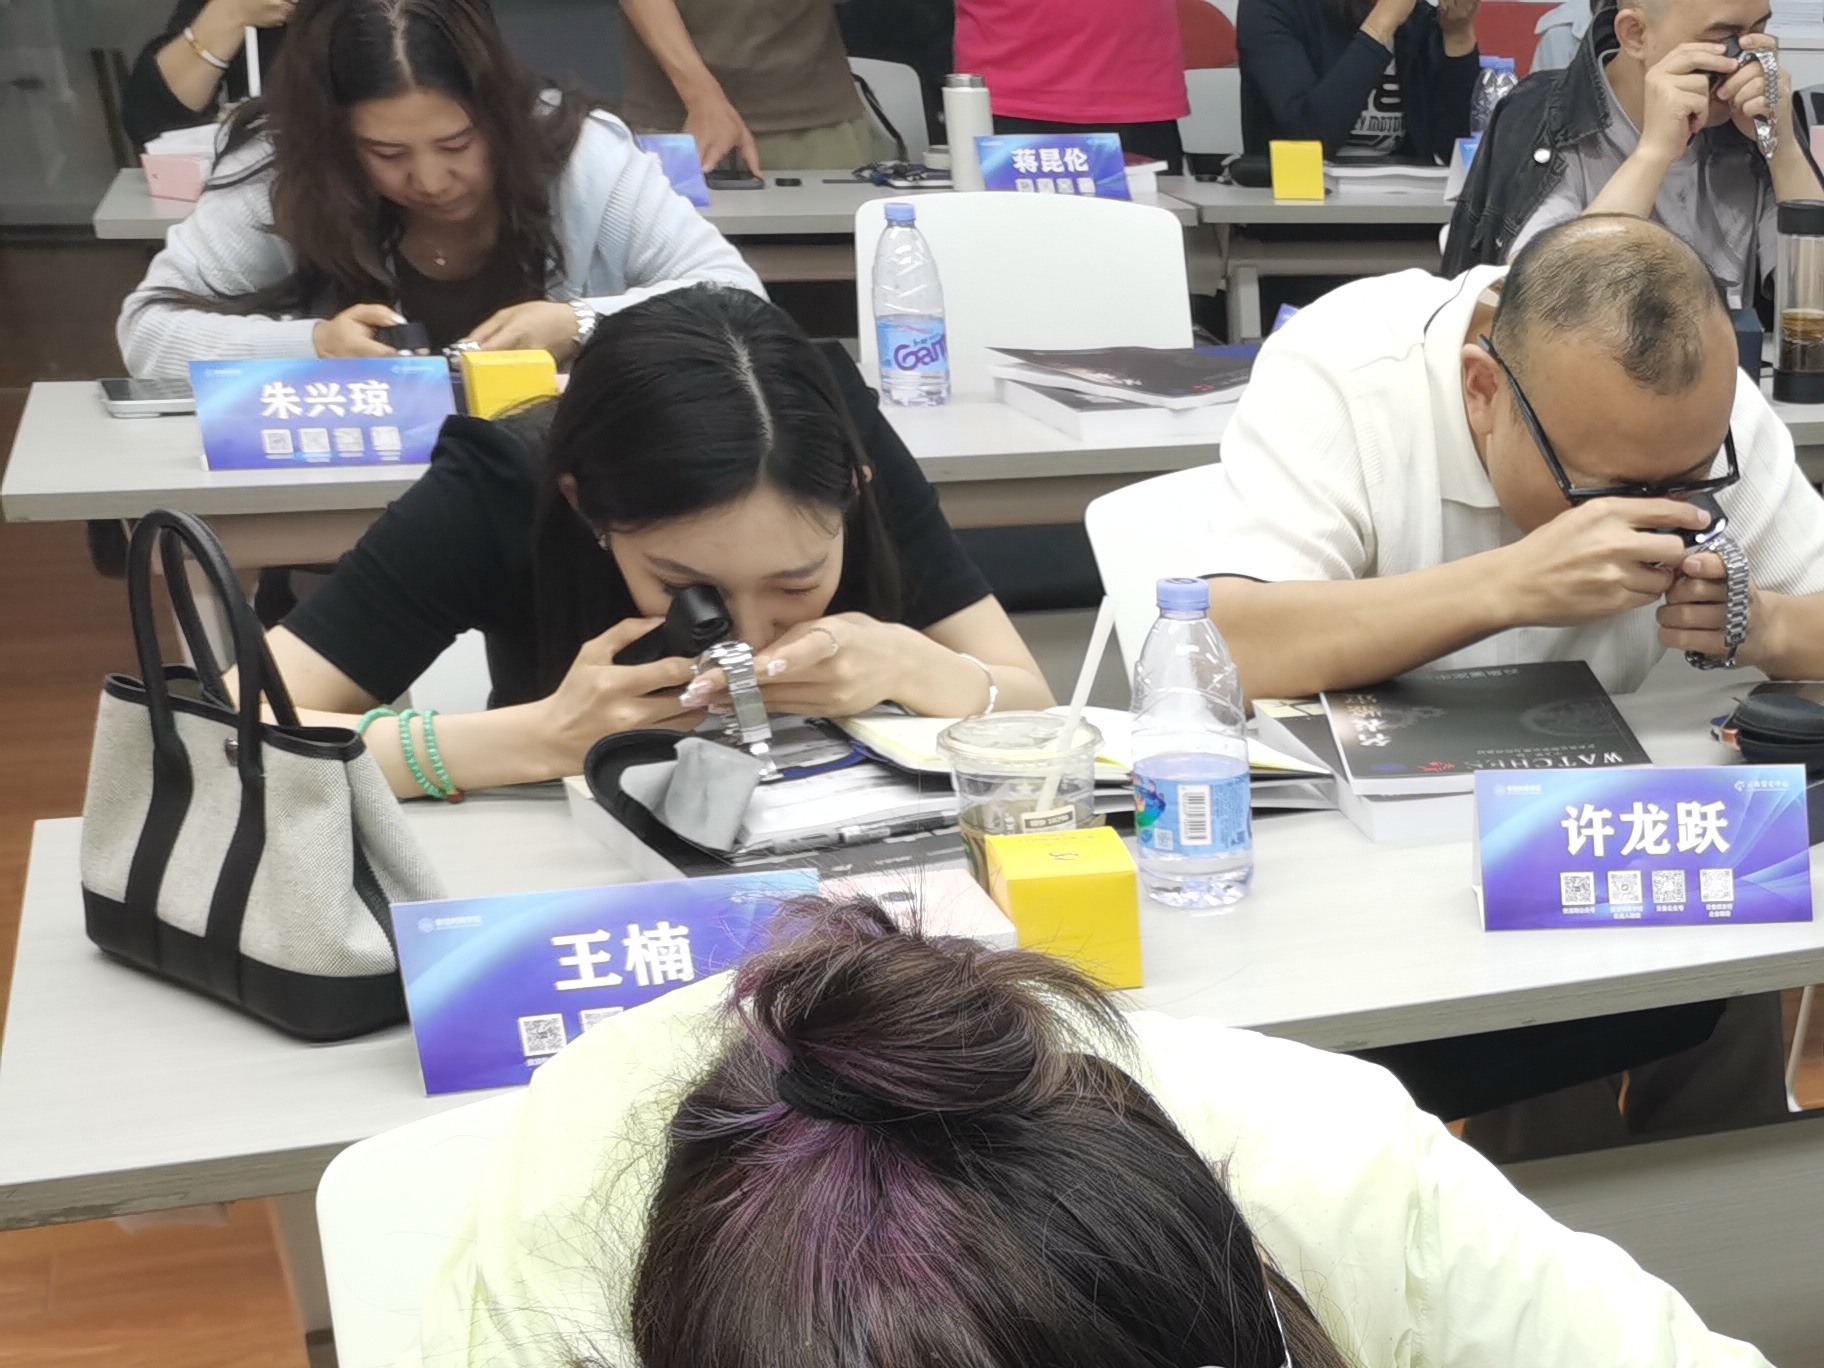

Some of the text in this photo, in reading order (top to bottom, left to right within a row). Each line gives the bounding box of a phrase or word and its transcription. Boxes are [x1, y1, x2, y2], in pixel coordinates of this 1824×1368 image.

[1012, 147, 1089, 173] 蒋昆伦
[260, 380, 394, 419] 朱兴琼
[1560, 801, 1731, 857] 许龙跃
[551, 921, 695, 992] 王楠
